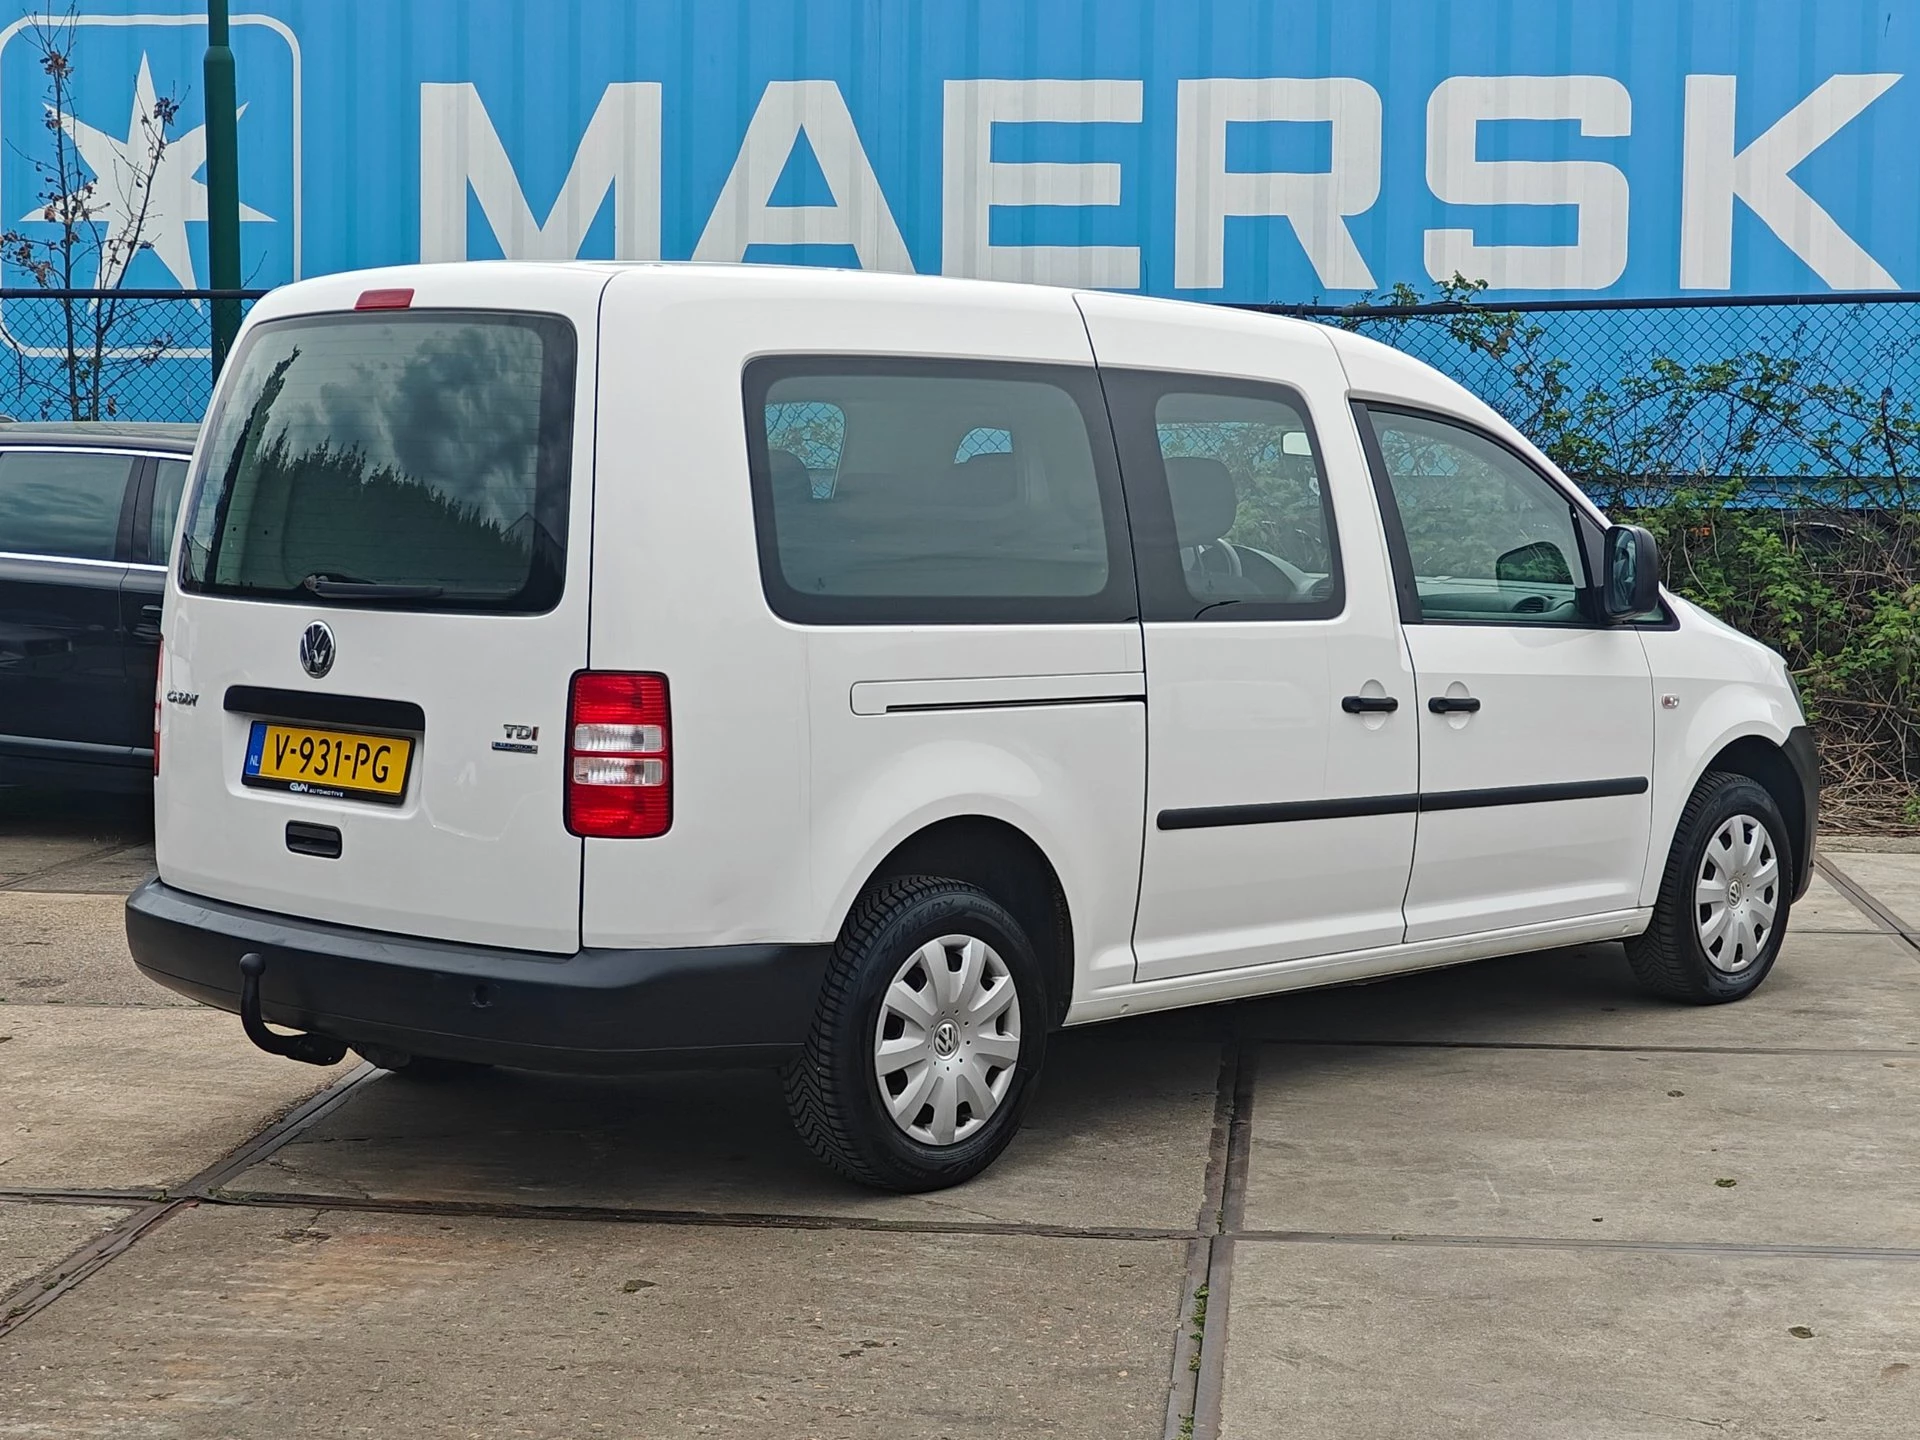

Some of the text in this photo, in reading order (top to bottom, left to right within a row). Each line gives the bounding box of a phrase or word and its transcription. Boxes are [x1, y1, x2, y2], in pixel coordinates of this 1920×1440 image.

[420, 73, 1904, 290] MAERSK
[503, 724, 539, 741] TDI
[249, 754, 260, 767] NL
[275, 733, 392, 783] V-931-PG
